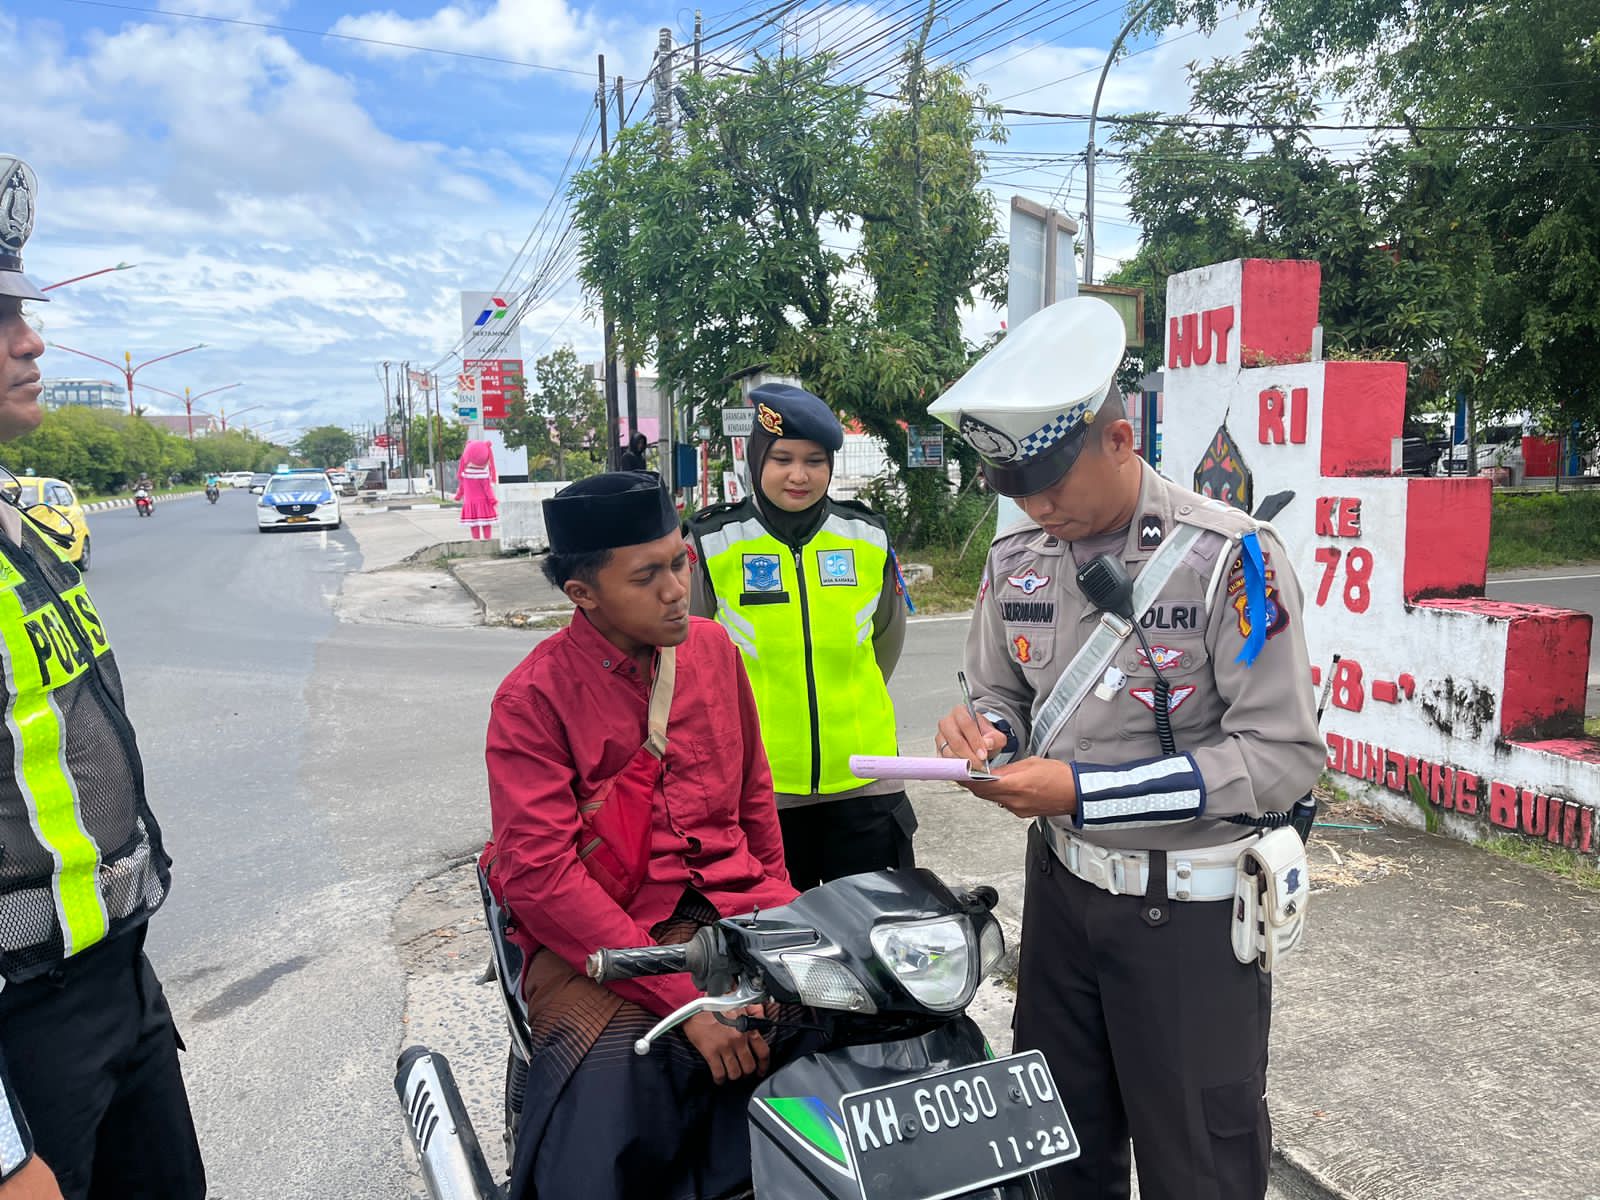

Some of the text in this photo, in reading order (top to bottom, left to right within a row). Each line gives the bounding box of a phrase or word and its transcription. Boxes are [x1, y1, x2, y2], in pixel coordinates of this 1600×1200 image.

[1168, 305, 1235, 369] HUT
[1258, 387, 1308, 445] RI
[1315, 496, 1362, 537] KE
[1314, 546, 1374, 614] 78
[23, 591, 106, 687] POLIS
[1140, 606, 1198, 630] OLRI
[850, 1062, 1055, 1152] KH 6030 TQ
